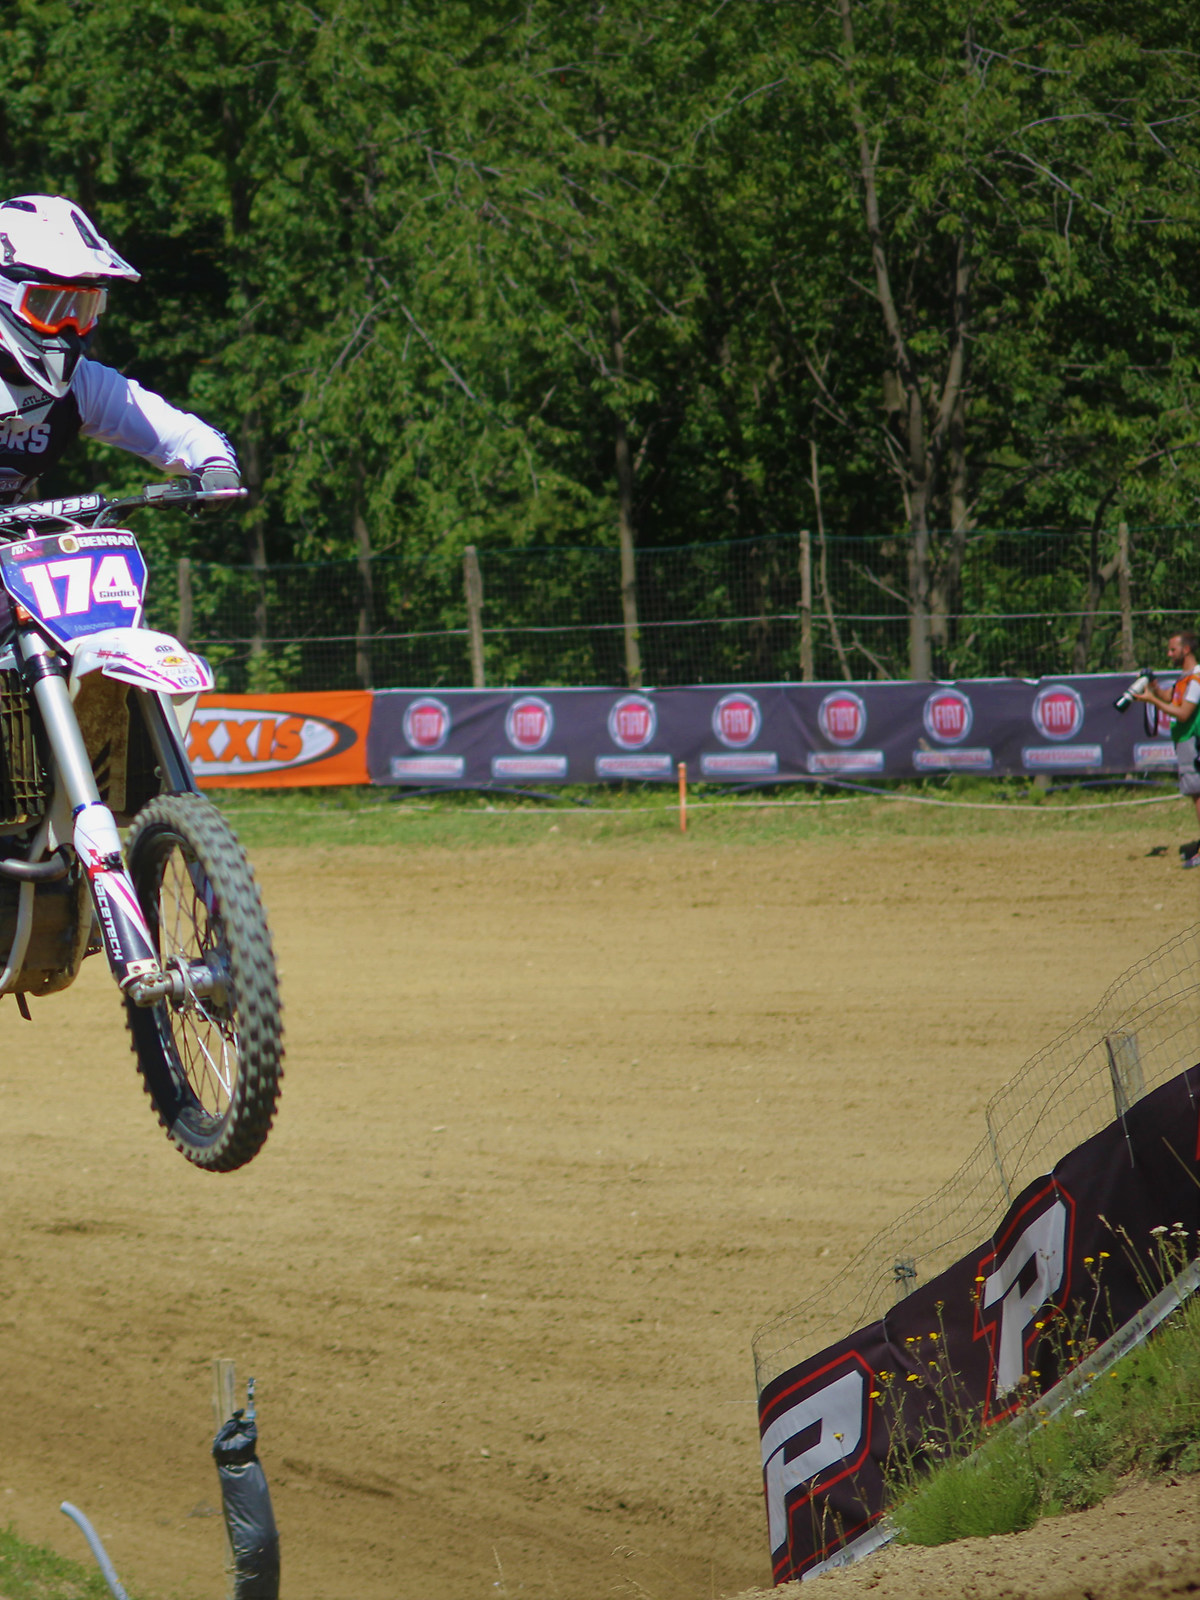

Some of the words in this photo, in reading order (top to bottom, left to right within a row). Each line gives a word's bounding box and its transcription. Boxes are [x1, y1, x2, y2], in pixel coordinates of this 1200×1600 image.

[21, 555, 141, 620] 174
[619, 711, 647, 735] FIAT
[723, 709, 749, 733] FIAT
[829, 707, 855, 731] FIAT
[934, 705, 961, 729] FIAT
[1044, 703, 1072, 727] FIAT
[187, 716, 306, 762] XXIS
[984, 1200, 1067, 1400] P
[761, 1370, 863, 1555] P
